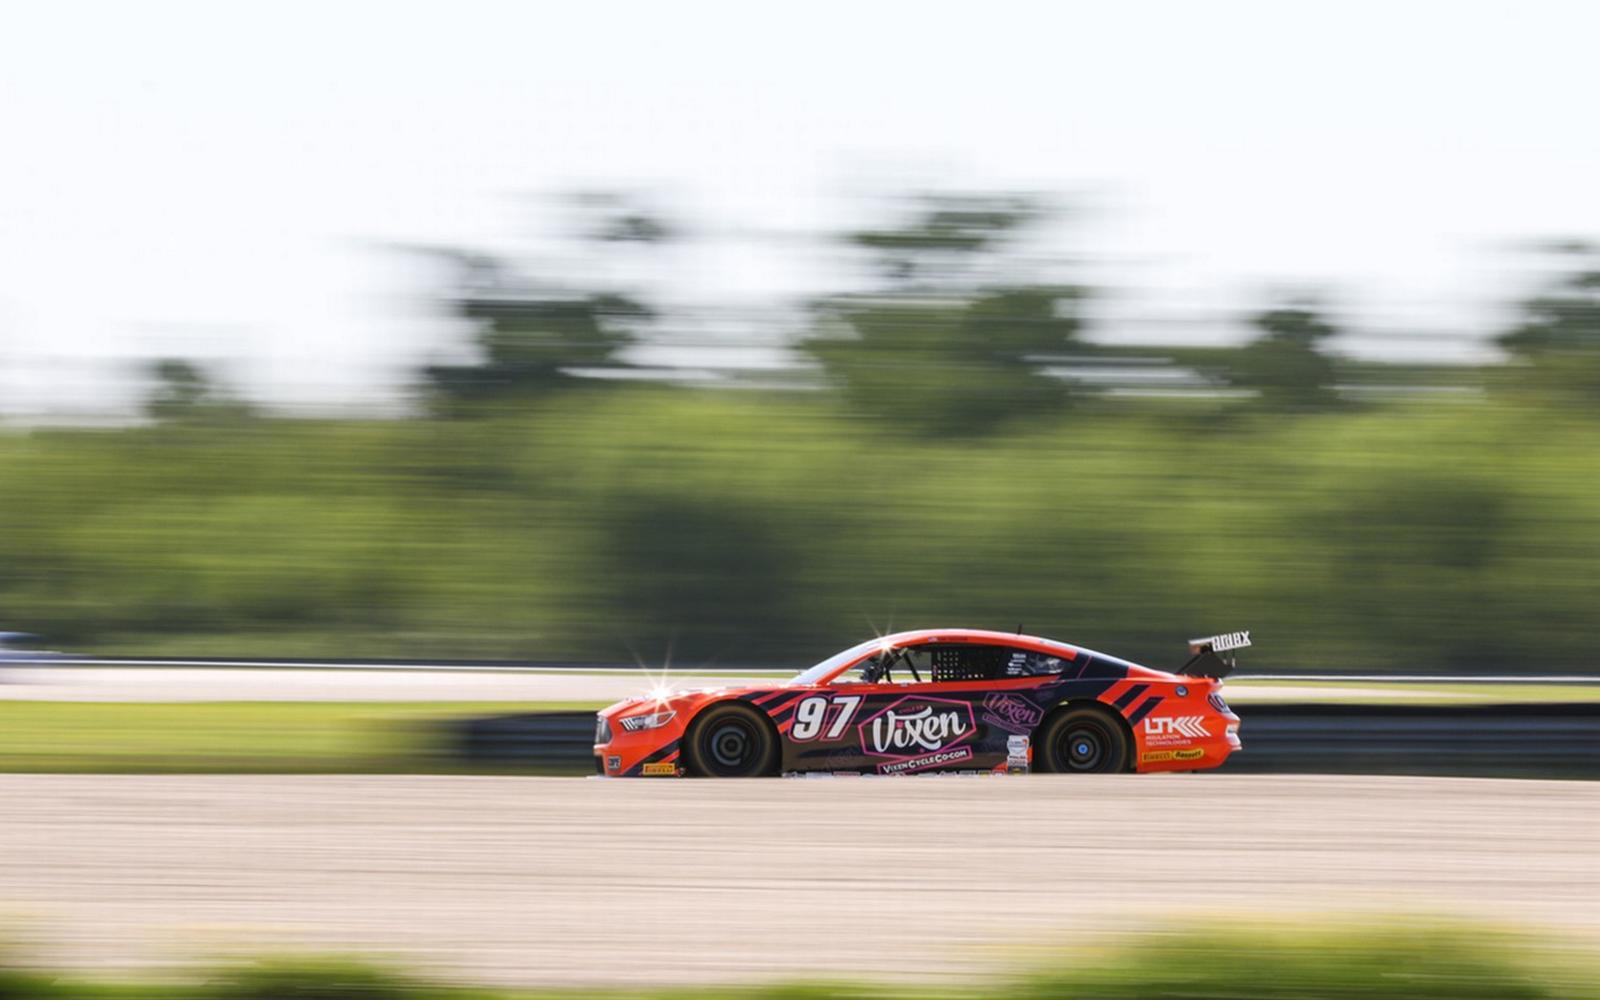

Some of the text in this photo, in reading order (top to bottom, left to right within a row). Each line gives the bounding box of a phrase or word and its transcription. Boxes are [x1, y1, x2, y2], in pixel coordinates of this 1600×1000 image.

[792, 696, 861, 740] 97
[989, 694, 1037, 724] Vixen
[1144, 716, 1193, 737] LTK
[872, 706, 967, 753] Vixen
